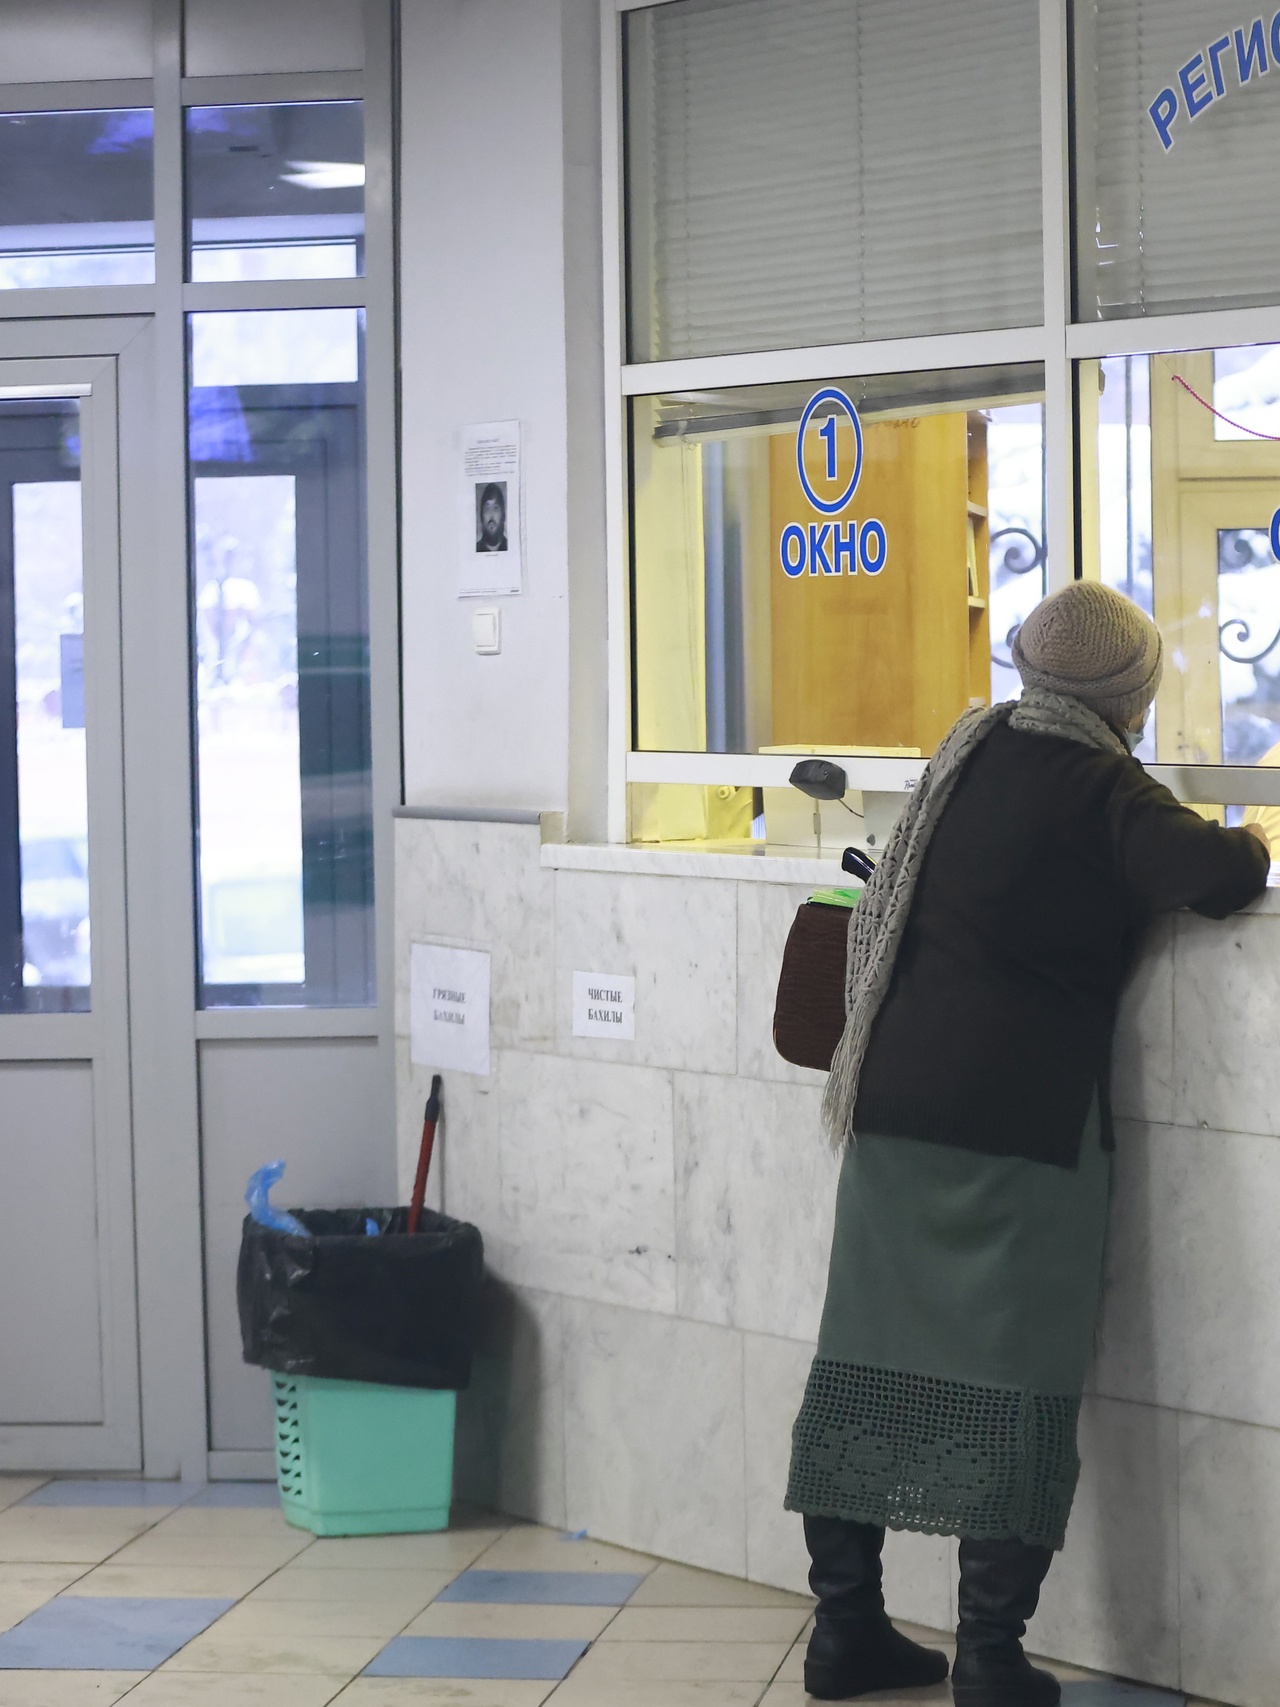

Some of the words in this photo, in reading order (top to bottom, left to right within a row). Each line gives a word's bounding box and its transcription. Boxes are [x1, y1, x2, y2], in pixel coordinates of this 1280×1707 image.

[819, 414, 837, 480] 1
[780, 518, 887, 578] ОКНО
[588, 988, 622, 1003] ЧИСТЫЕ
[588, 1008, 622, 1024] БАХИЛЫ
